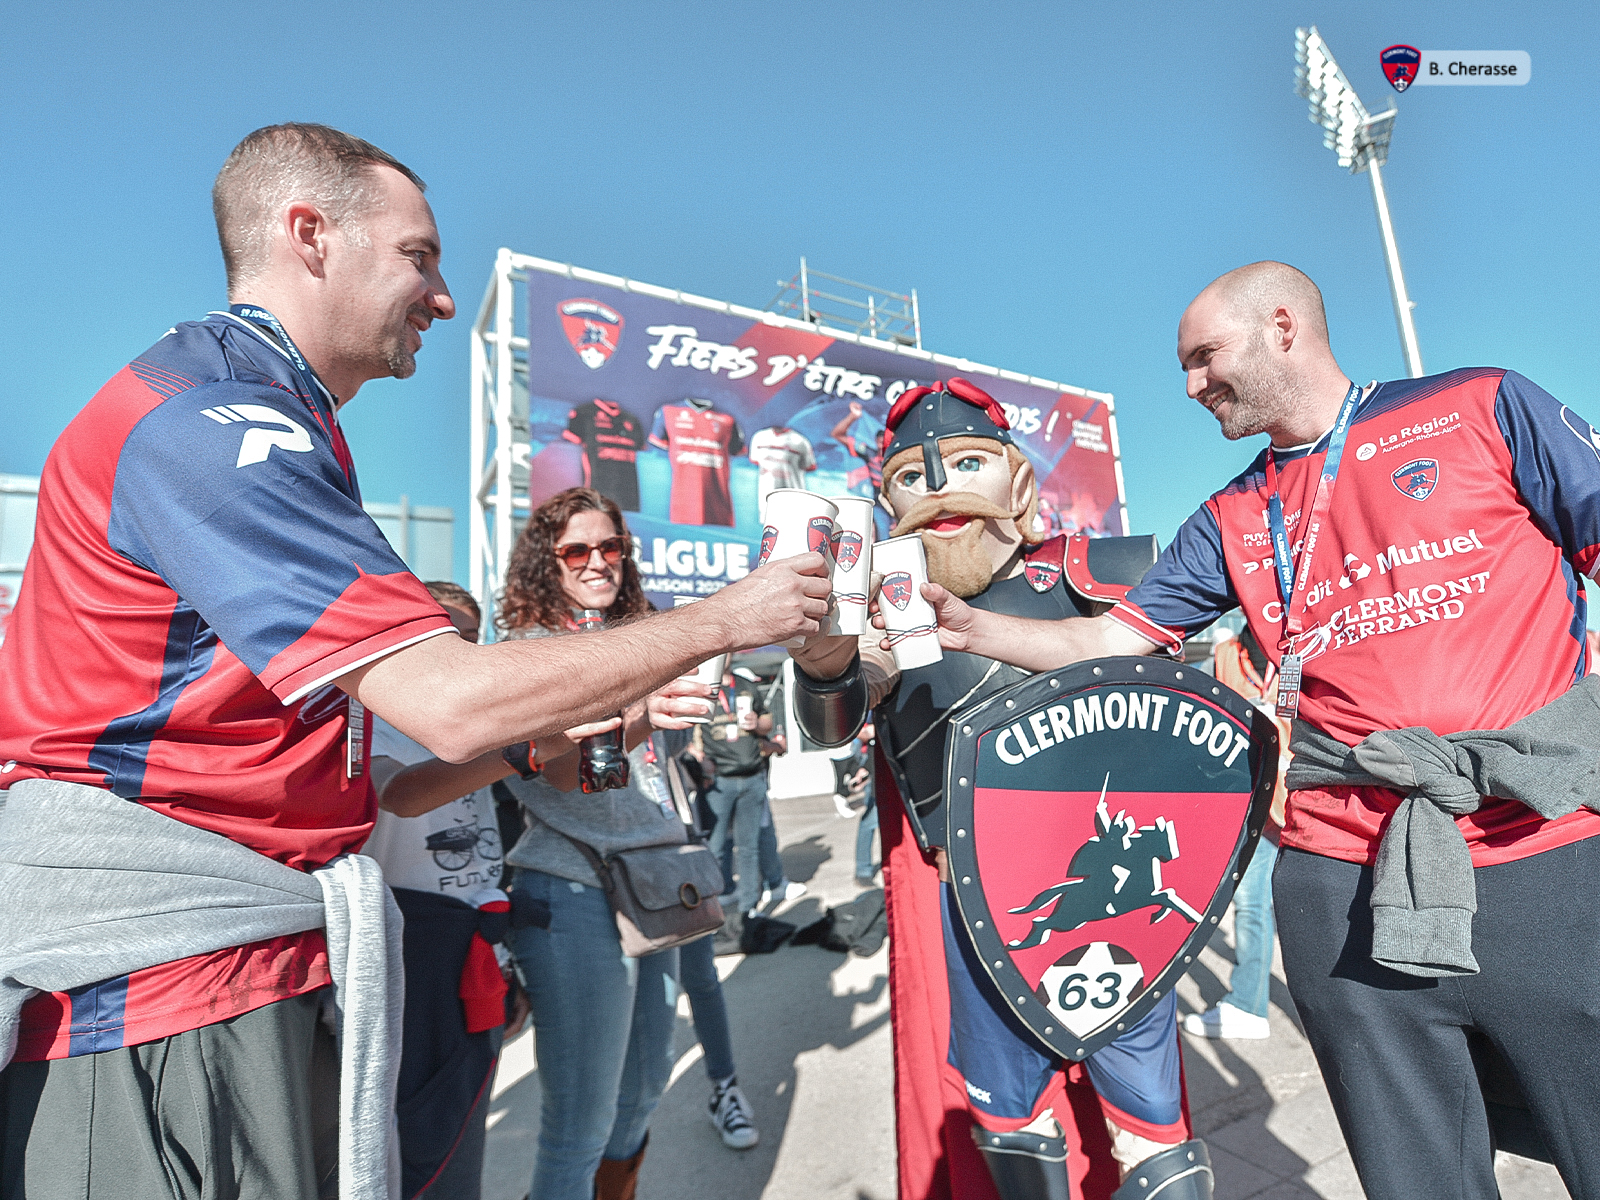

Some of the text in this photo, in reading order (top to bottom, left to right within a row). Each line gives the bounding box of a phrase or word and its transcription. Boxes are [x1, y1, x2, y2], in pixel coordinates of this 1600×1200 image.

[1379, 411, 1460, 447] La Région
[1382, 422, 1462, 454] Auvergne-Rhône-Alpes
[632, 536, 749, 580] LIGUE
[1262, 528, 1484, 623] Cdit Mutuel
[1330, 571, 1490, 631] CLERMONT
[1333, 599, 1465, 650] FERRAND
[995, 691, 1250, 769] CLERMONT FOOT
[1057, 971, 1122, 1011] 63
